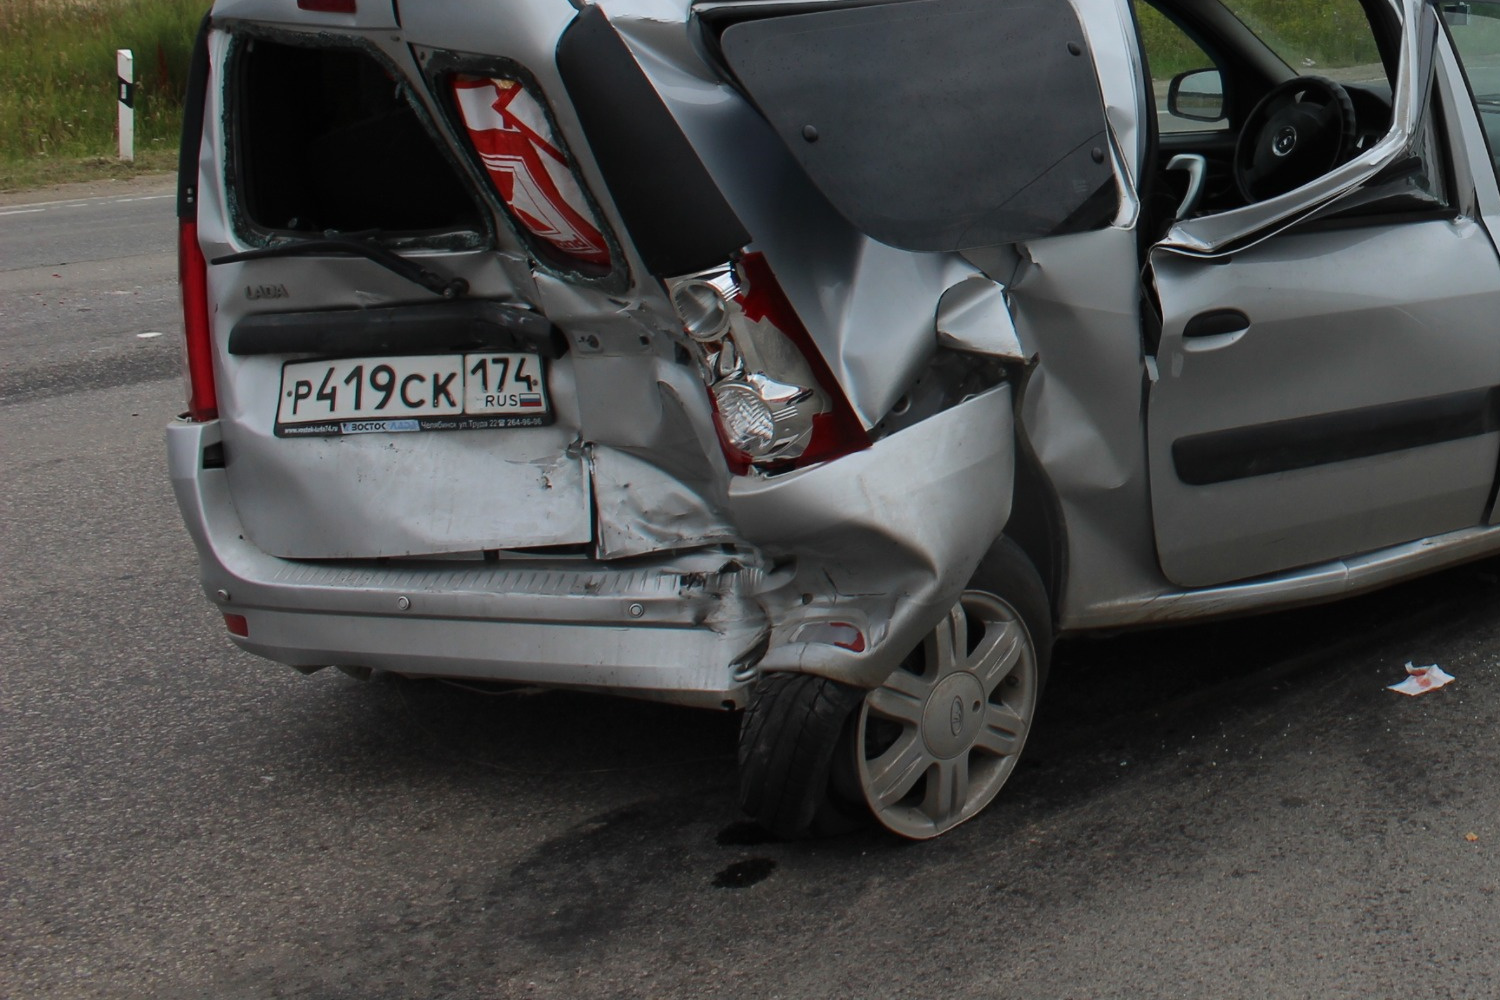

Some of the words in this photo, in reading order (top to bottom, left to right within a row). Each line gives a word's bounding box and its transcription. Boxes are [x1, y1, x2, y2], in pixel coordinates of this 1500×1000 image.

[243, 283, 290, 301] LADA
[292, 364, 457, 416] Р419СК
[470, 357, 533, 393] 174
[485, 394, 519, 408] RUS
